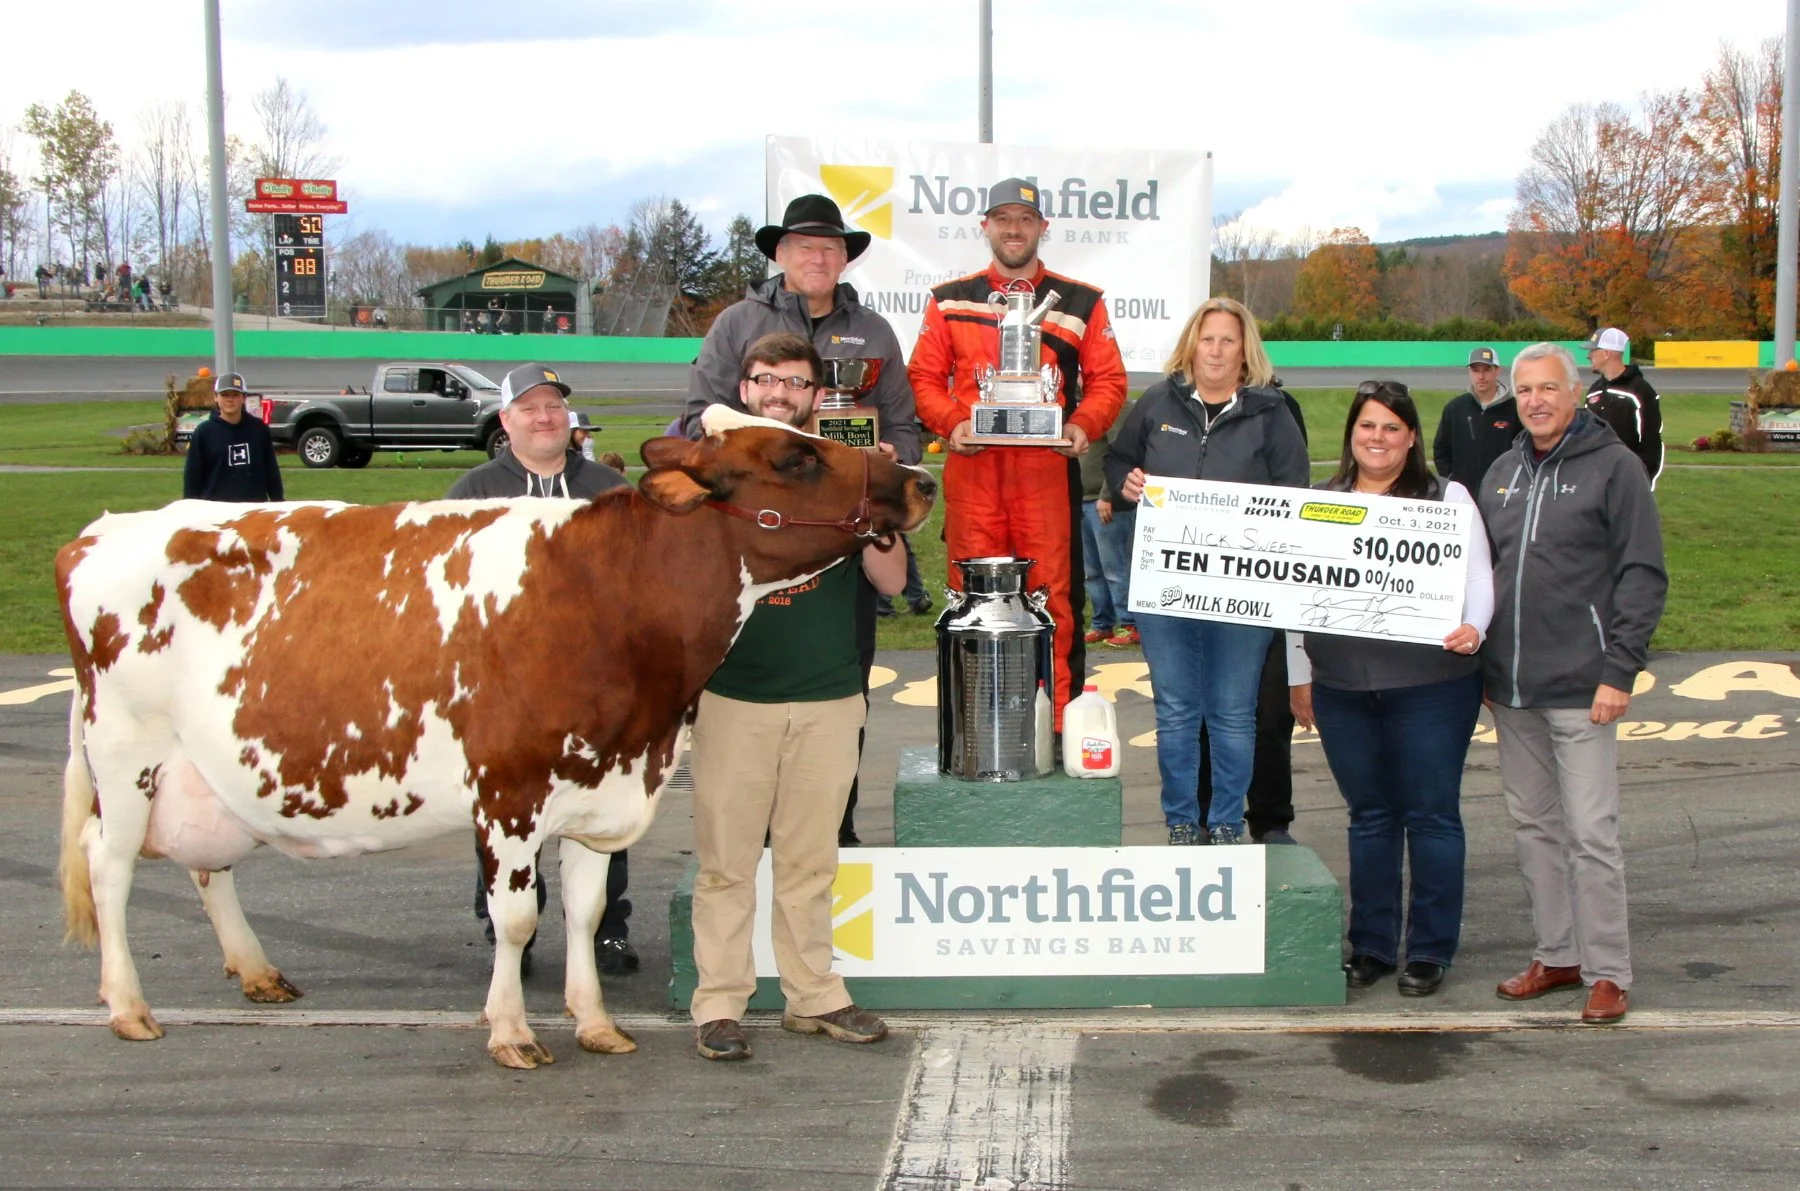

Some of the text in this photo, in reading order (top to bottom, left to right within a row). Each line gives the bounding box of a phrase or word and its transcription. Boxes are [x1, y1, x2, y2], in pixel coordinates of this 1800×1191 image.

[908, 175, 1160, 220] Norhfield
[278, 237, 320, 245] LAP TIME
[938, 226, 1130, 244] SAVS BANK
[279, 248, 294, 256] POS
[282, 260, 289, 273] 1
[282, 281, 290, 294] 2
[283, 302, 291, 315] 3
[864, 291, 932, 314] ANNU
[1114, 298, 1171, 320] BOWL
[847, 431, 871, 439] Bowl
[1168, 489, 1240, 508] Northfield
[1248, 496, 1292, 508] MILK
[1243, 507, 1293, 520] BOWL
[1305, 505, 1340, 515] THUNDER
[1340, 508, 1361, 517] ROAD
[1417, 505, 1458, 517] 66021
[1143, 526, 1156, 534] PAY
[1378, 516, 1457, 532] Oct. 3, 2021
[1143, 535, 1154, 543] TO:
[1140, 557, 1155, 565] Sum
[1161, 550, 1414, 594] TEN THOUSAND 00/100
[768, 597, 791, 605] 2018
[1419, 592, 1454, 602] DOLLARS
[1136, 600, 1159, 609] MEMO:
[1182, 594, 1223, 613] MILK
[1225, 599, 1273, 619] BOWL
[895, 867, 1236, 924] Northfield
[936, 936, 1197, 956] SAVINGS BANK
